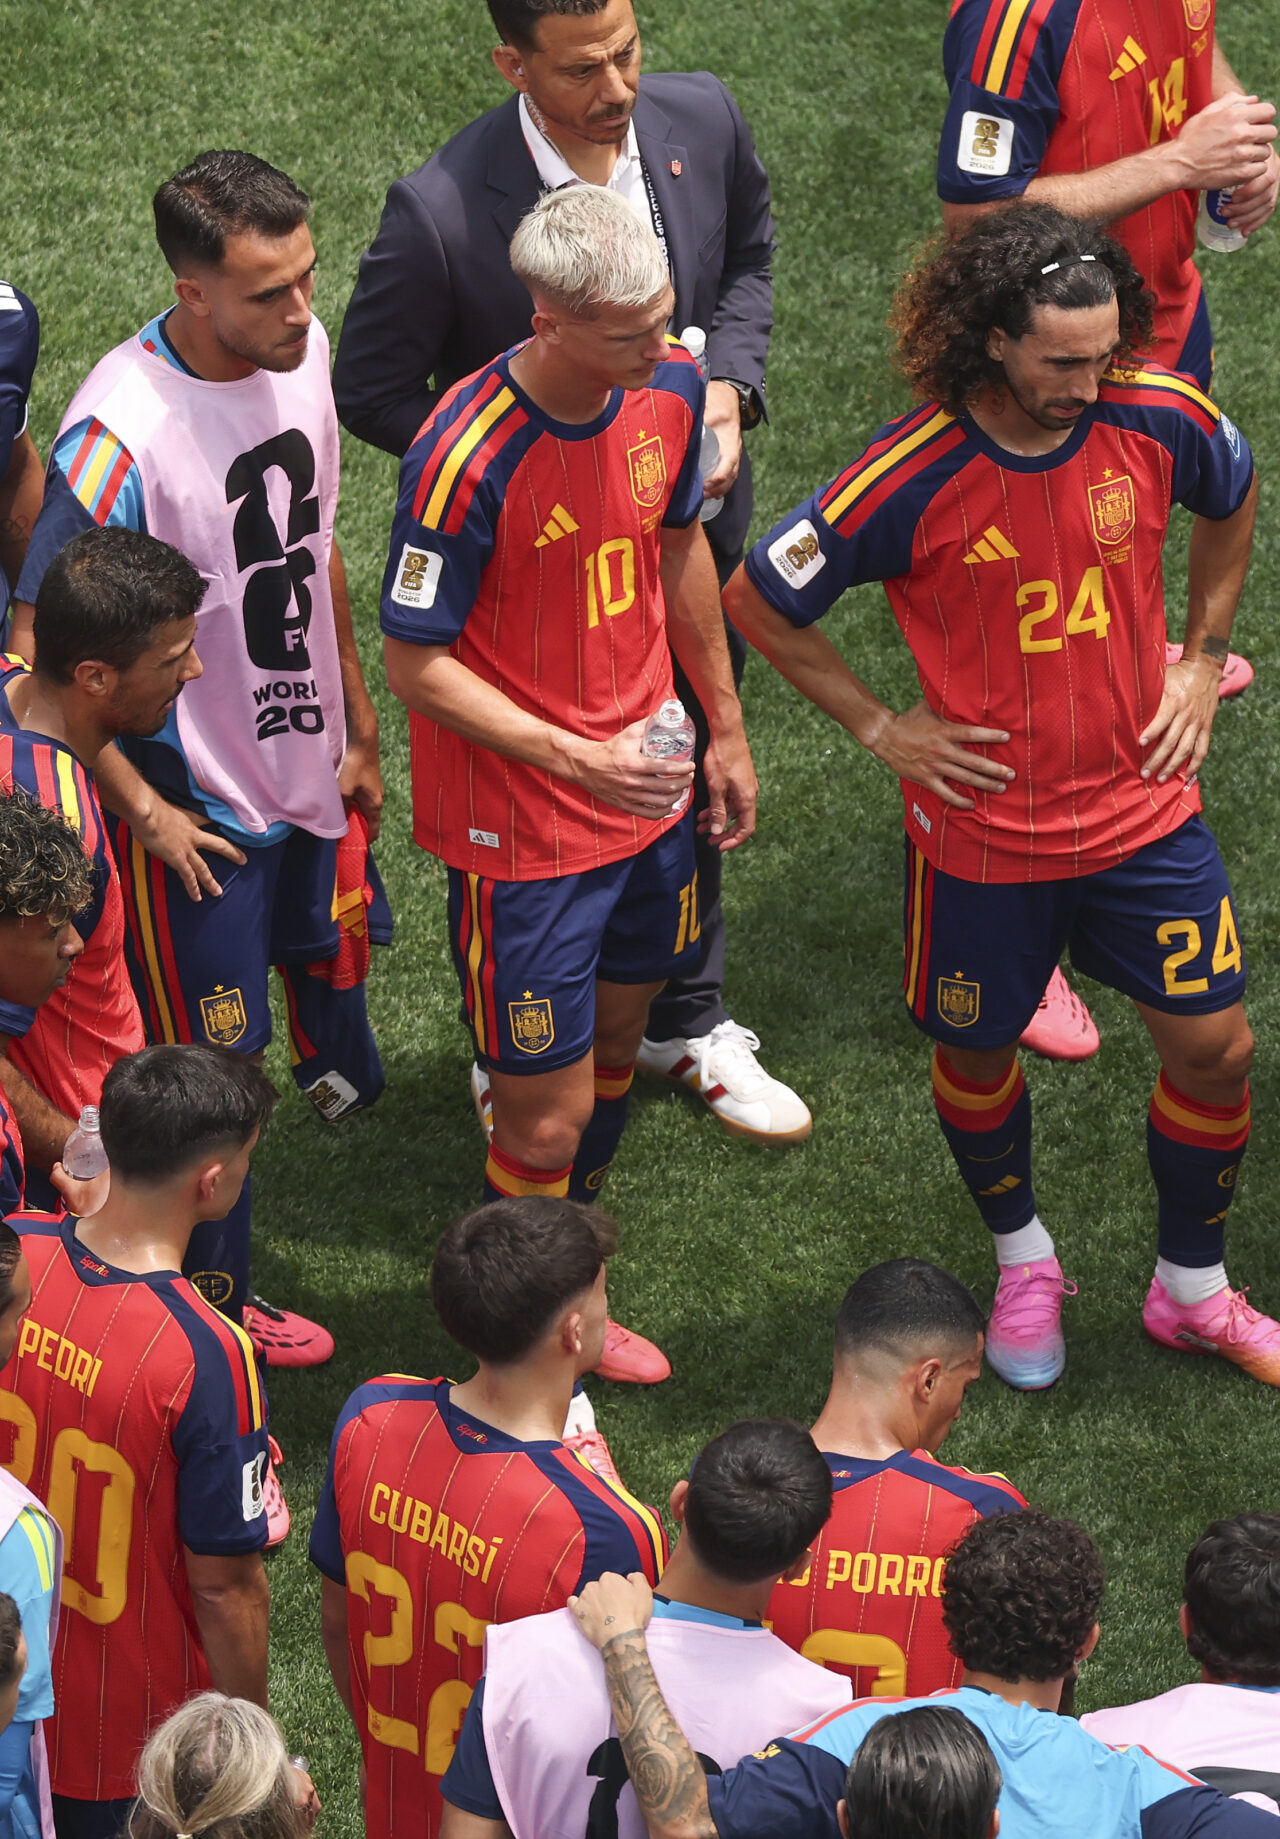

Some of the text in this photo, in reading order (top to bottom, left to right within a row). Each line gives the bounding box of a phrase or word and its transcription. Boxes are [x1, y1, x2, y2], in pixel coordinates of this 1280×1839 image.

[1149, 57, 1187, 145] 14
[585, 537, 635, 629] 10
[1016, 565, 1111, 654] 24
[256, 705, 325, 742] 20
[1156, 895, 1242, 995] 24
[18, 1318, 103, 1398] PEDRI
[369, 1482, 504, 1584] CUBARSÍ
